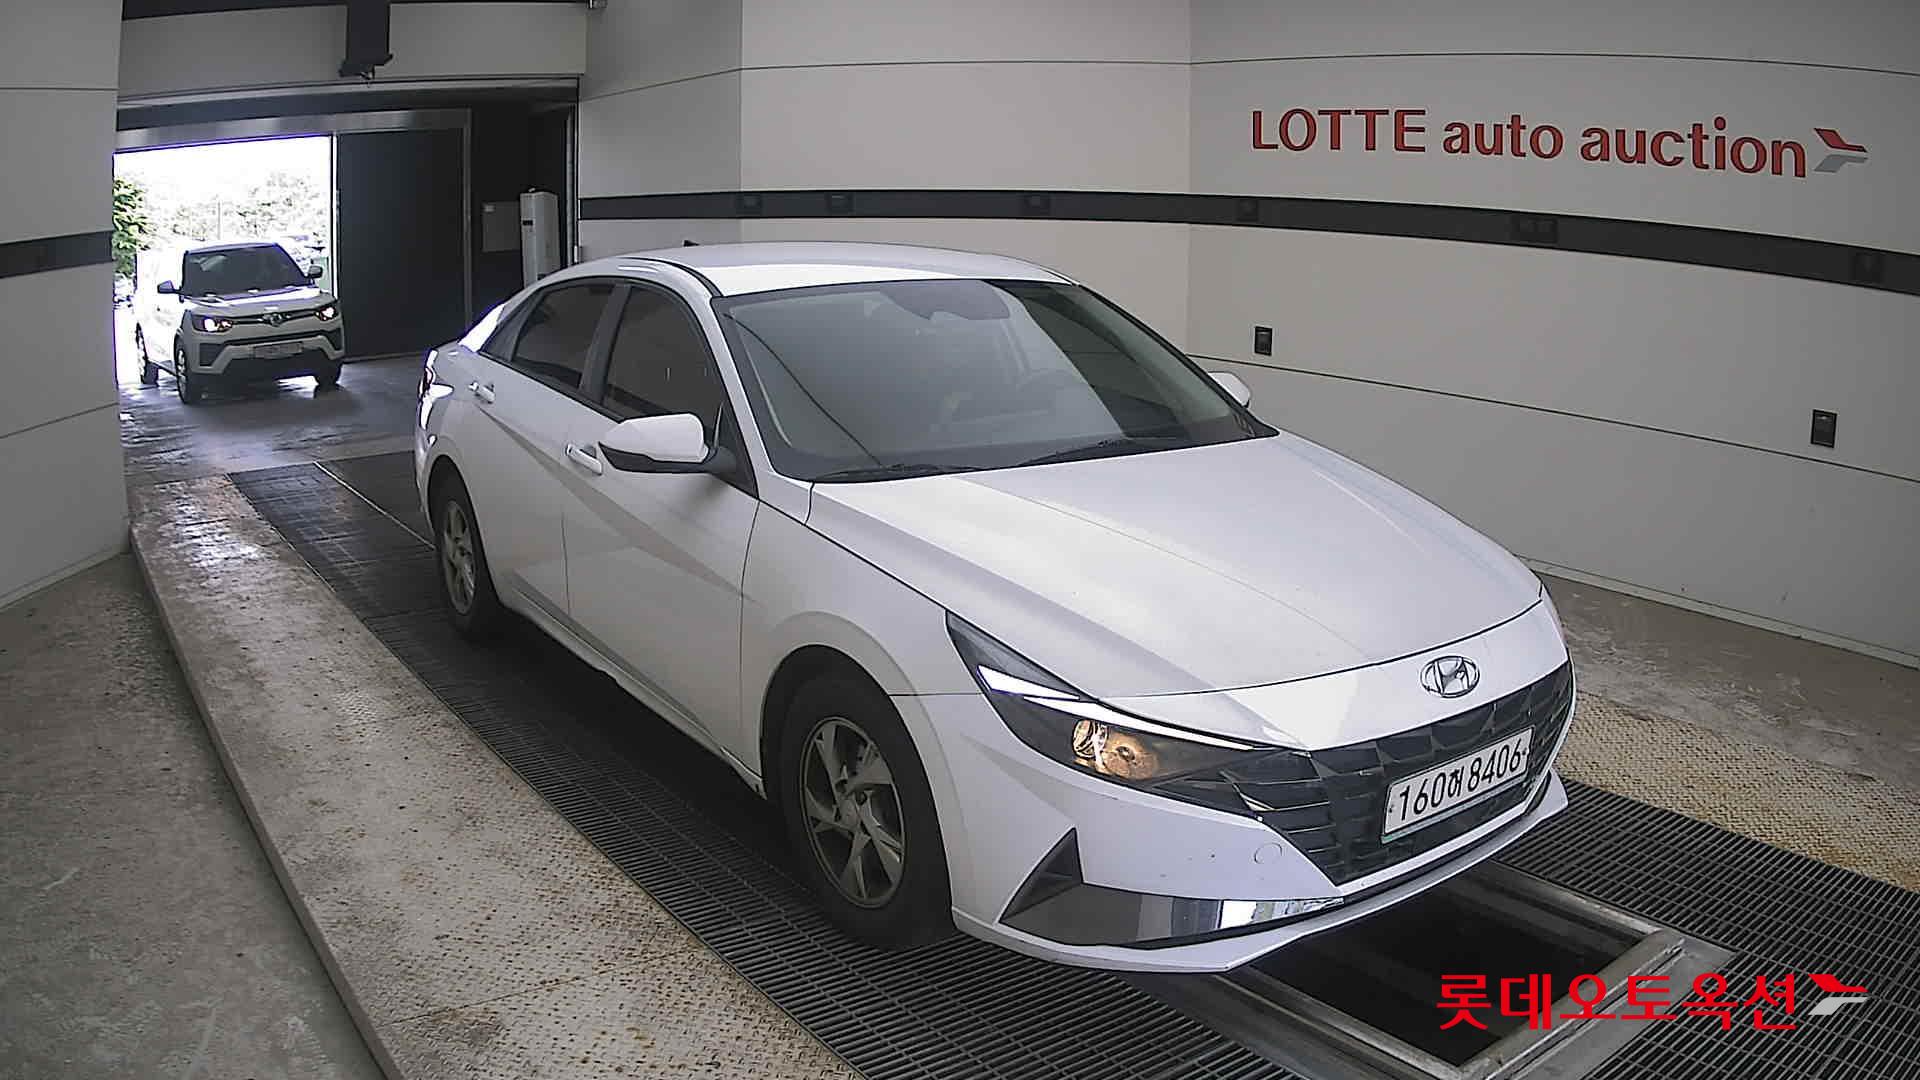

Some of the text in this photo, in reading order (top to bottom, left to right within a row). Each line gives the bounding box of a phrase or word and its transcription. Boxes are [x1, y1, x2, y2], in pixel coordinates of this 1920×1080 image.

[1251, 108, 1808, 179] LOTTE auto auction
[1467, 738, 1523, 792] 8406
